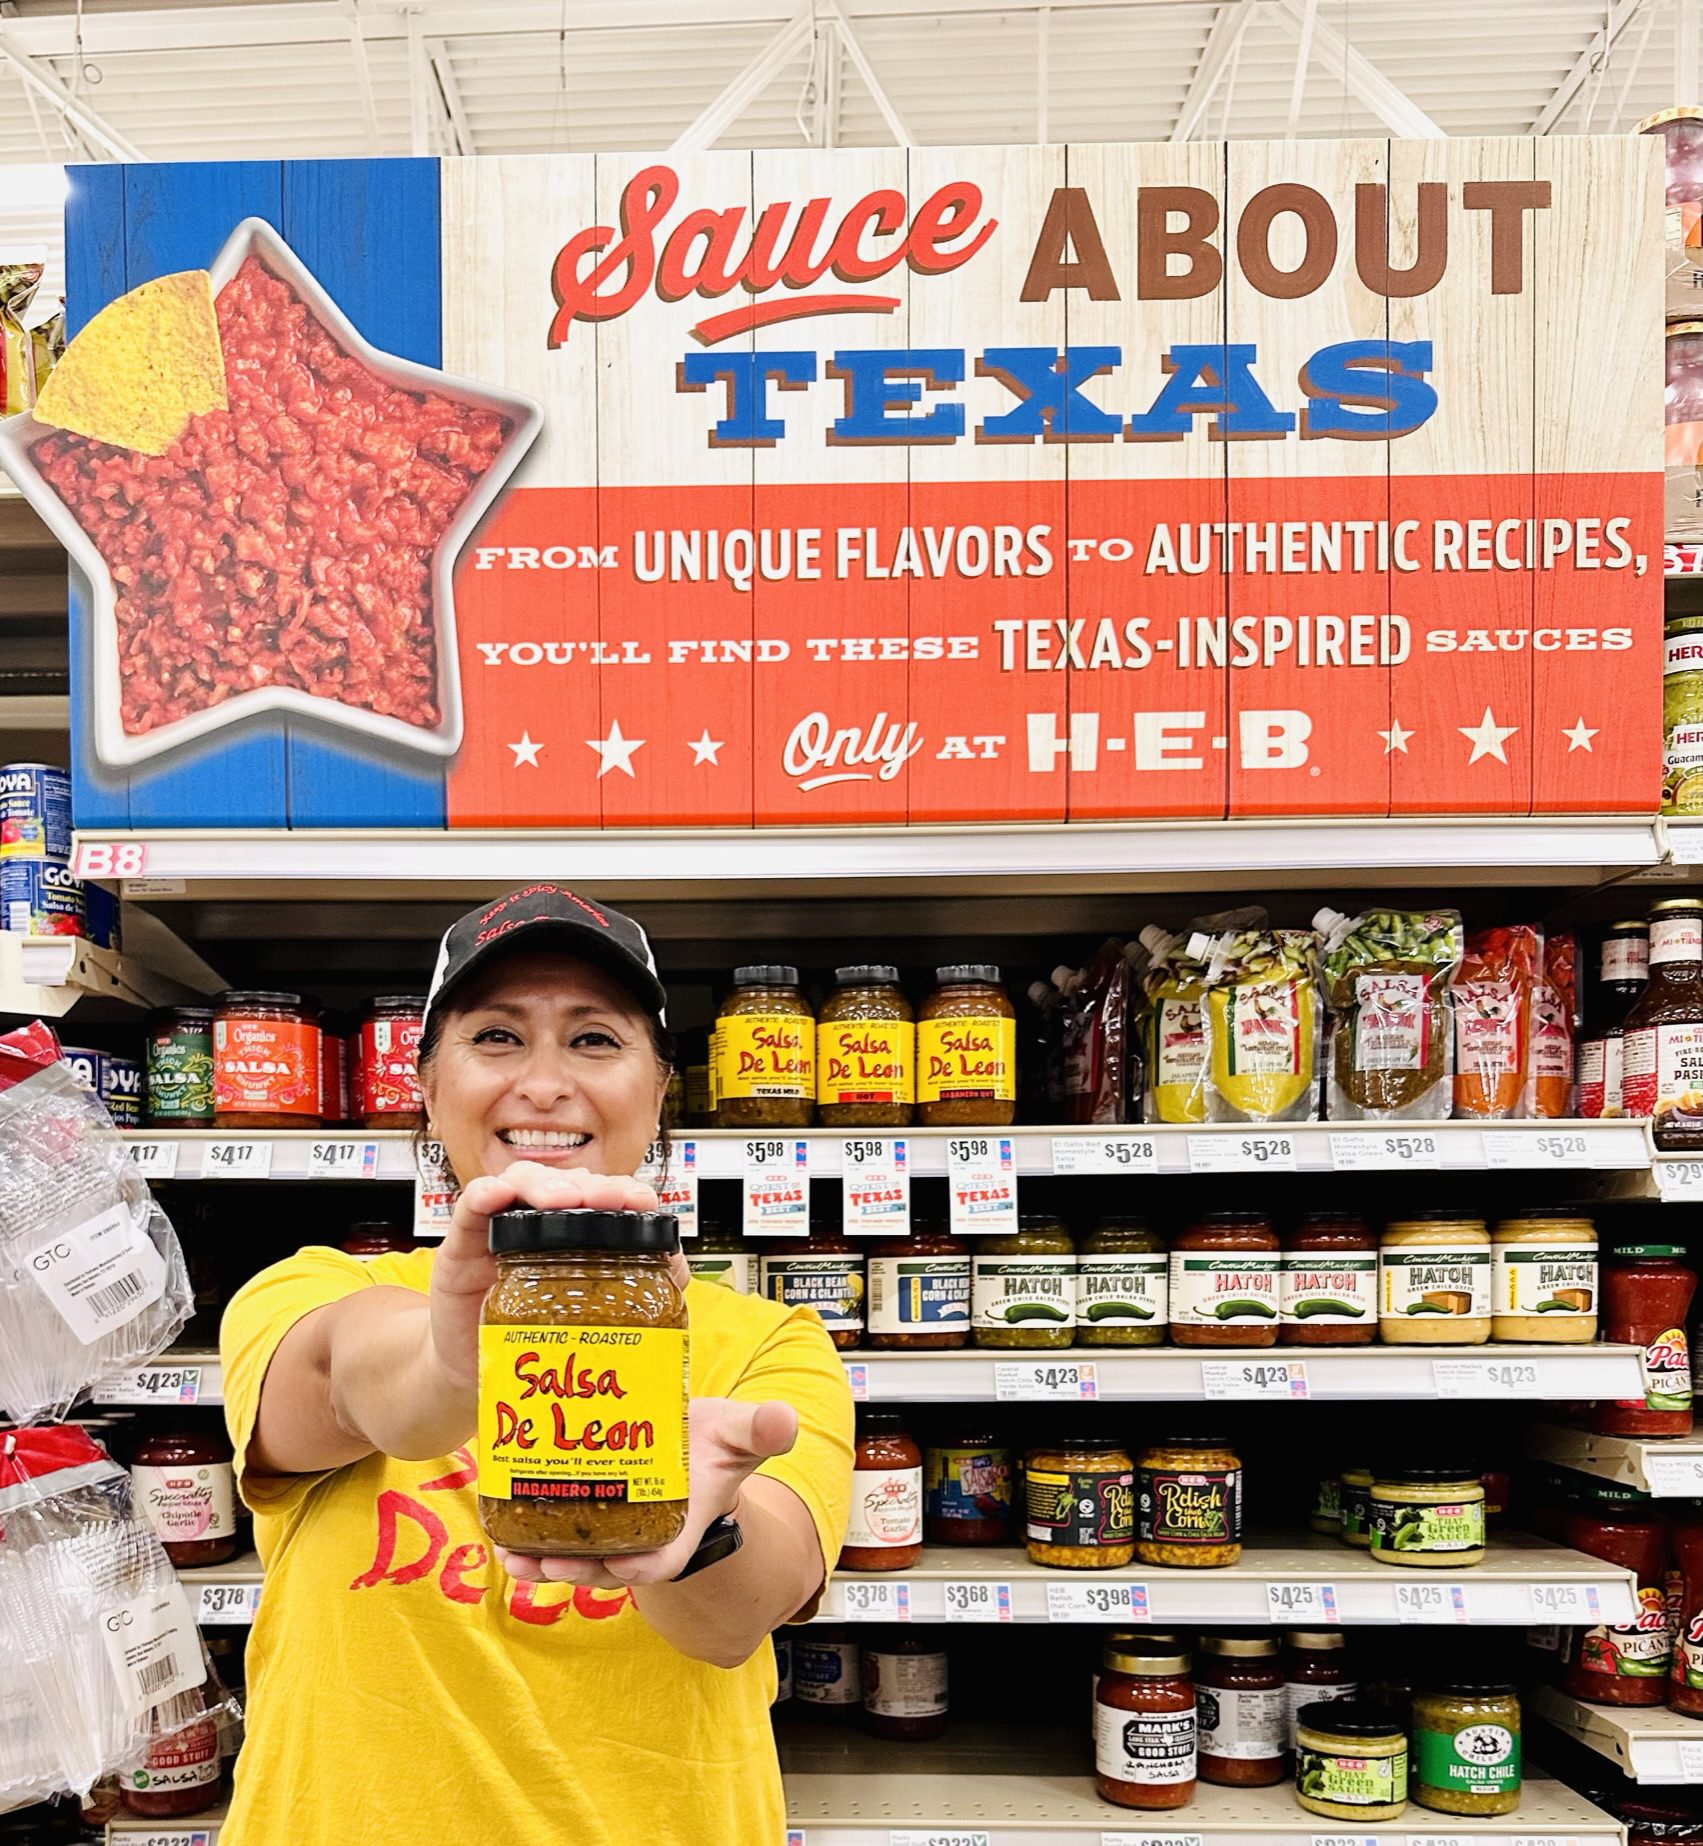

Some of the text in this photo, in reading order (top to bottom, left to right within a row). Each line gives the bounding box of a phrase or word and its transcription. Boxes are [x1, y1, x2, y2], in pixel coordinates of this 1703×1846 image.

[547, 165, 1552, 350] Sauce ABOUT
[675, 339, 1439, 449] TEXAS
[475, 546, 619, 570] FROM
[633, 529, 822, 593] UNIQUE
[834, 525, 1054, 580] FLAVORS
[1067, 537, 1134, 562] TO
[1143, 519, 1421, 577] AUTHENTIC
[1431, 517, 1648, 578] RECIPES,
[476, 614, 1634, 674] YOU'LL FIND THESE TEXAS-INSPIRED SAUCES
[781, 710, 1313, 791] Only AT H-E-B
[79, 844, 143, 876] B8
[1359, 978, 1419, 1001] SALSA
[233, 1028, 277, 1045] Organics
[751, 1026, 803, 1050] Salsa
[839, 1031, 892, 1057] Salsa
[940, 1030, 994, 1055] Salsa
[224, 1060, 291, 1075] SALSA
[737, 1050, 766, 1075] De
[827, 1055, 904, 1082] De Leon
[928, 1053, 1006, 1080] De Leon
[1680, 1057, 1703, 1069] SAL
[149, 1071, 201, 1085] SALSA
[856, 1092, 876, 1100] HOT
[211, 1145, 254, 1165] $417
[312, 1144, 356, 1165] $417
[746, 1141, 784, 1163] $598
[845, 1141, 883, 1163] $598
[950, 1140, 988, 1162] $598
[1104, 1142, 1154, 1164] $528
[1241, 1139, 1292, 1162] $528
[1384, 1137, 1436, 1160] $528
[1536, 1136, 1587, 1159] $528
[750, 1189, 803, 1207] TEXAS
[850, 1189, 903, 1207] TEXAS
[956, 1188, 1010, 1205] TEXAS
[33, 1243, 72, 1272] GTC
[1613, 1246, 1644, 1255] MILD
[792, 1276, 824, 1289] BLACK
[931, 1278, 957, 1290] BLACK
[1214, 1273, 1273, 1293] HATCH
[1293, 1272, 1357, 1292] HATCH
[1409, 1266, 1473, 1286] HATCH
[1539, 1264, 1594, 1284] HATCH
[784, 1288, 809, 1300] CORN
[810, 1288, 817, 1299] &
[922, 1289, 946, 1302] CORN
[1003, 1276, 1062, 1297] HATCH
[1085, 1275, 1146, 1295] HATCH
[503, 1331, 642, 1345] AUTHENTIC ROASTED
[137, 1373, 181, 1394] $423
[514, 1351, 628, 1401] Salsa
[1034, 1368, 1079, 1390] $423
[1242, 1366, 1288, 1388] $423
[1487, 1366, 1537, 1388] $423
[492, 1400, 654, 1452] De Leon
[492, 1455, 510, 1463] Best
[512, 1456, 542, 1465] salsa
[545, 1457, 583, 1467] you'll
[619, 1457, 653, 1466] taste!
[149, 1486, 214, 1506] Specialty
[512, 1482, 626, 1498] HABANERO HOT
[1158, 1482, 1222, 1511] Relish
[1598, 1489, 1632, 1499] MILD
[166, 1519, 197, 1528] Garlic
[1165, 1507, 1207, 1529] Corn
[1427, 1523, 1471, 1534] Green
[1435, 1517, 1464, 1525] THAT
[349, 1489, 491, 1605] De
[1427, 1532, 1471, 1541] SAUCE
[203, 1588, 245, 1611] $378
[847, 1585, 888, 1608] $378
[947, 1586, 989, 1609] $368
[1086, 1588, 1131, 1612] $398
[1270, 1586, 1313, 1609] $425
[1399, 1586, 1442, 1610] $425
[1533, 1586, 1577, 1611] $425
[107, 1610, 133, 1632] GC
[1138, 1720, 1191, 1734] MARK'S
[152, 1749, 209, 1767] GOOD STUFF
[1138, 1744, 1192, 1757] GOOD STUFF
[152, 1771, 198, 1786] SALSA
[1328, 1777, 1375, 1787] Green
[1449, 1764, 1515, 1779] HATCH CHILE
[1328, 1784, 1375, 1795] SAUCE
